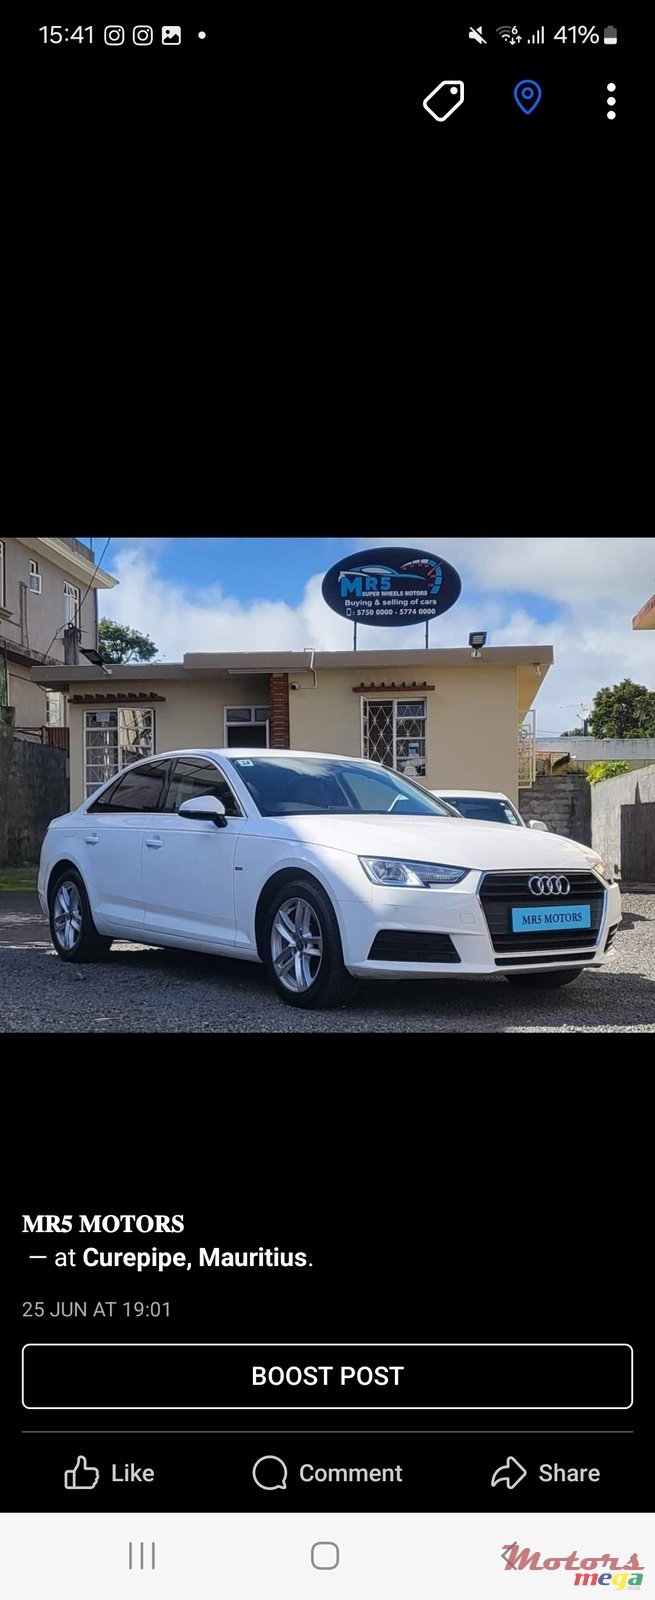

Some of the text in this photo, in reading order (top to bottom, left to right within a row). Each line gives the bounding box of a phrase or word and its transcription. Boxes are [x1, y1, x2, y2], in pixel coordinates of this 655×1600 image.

[341, 576, 392, 597] MR5
[345, 599, 373, 607] Buying
[382, 599, 409, 607] selling
[375, 608, 394, 616] 0000
[522, 912, 583, 925] MR5 MOTORS
